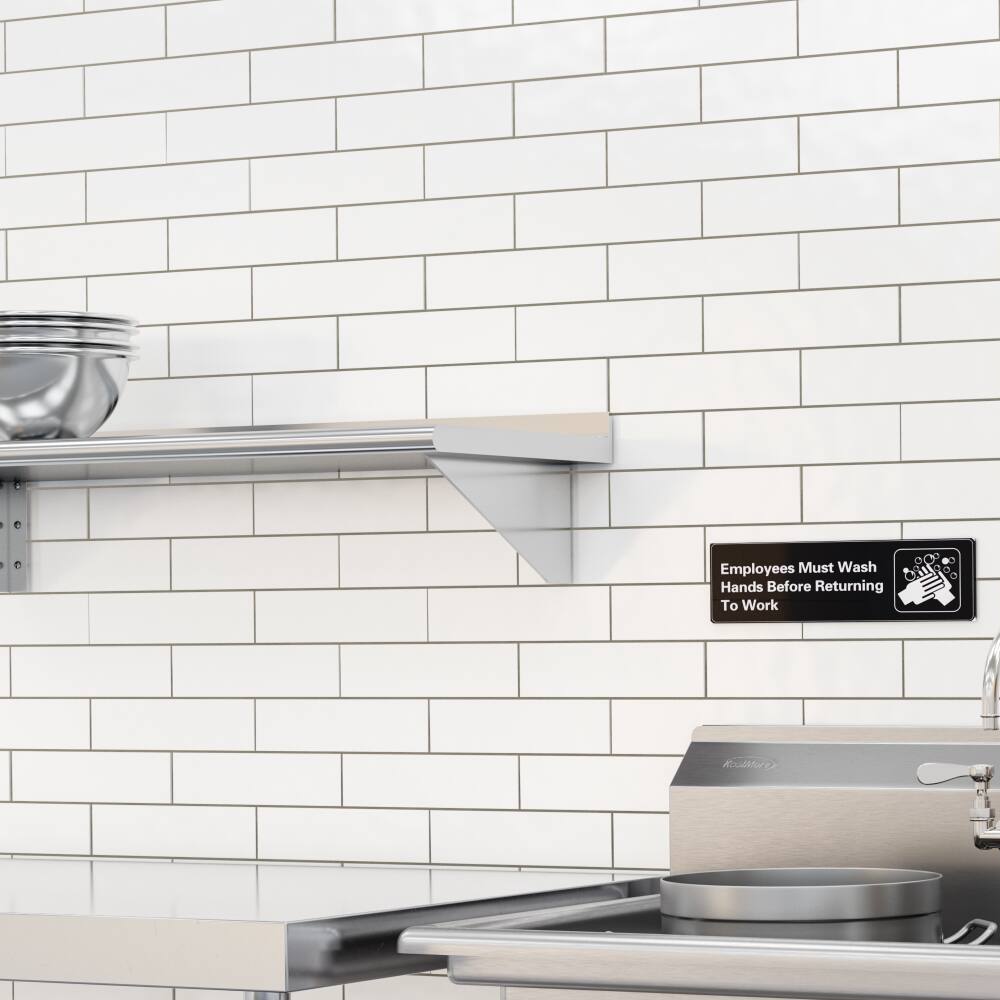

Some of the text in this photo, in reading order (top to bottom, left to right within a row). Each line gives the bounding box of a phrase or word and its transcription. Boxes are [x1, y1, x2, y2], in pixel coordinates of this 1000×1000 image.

[720, 560, 877, 577] Employees Must Wash
[720, 579, 884, 594] Hands Before Returning
[720, 598, 779, 612] To Work
